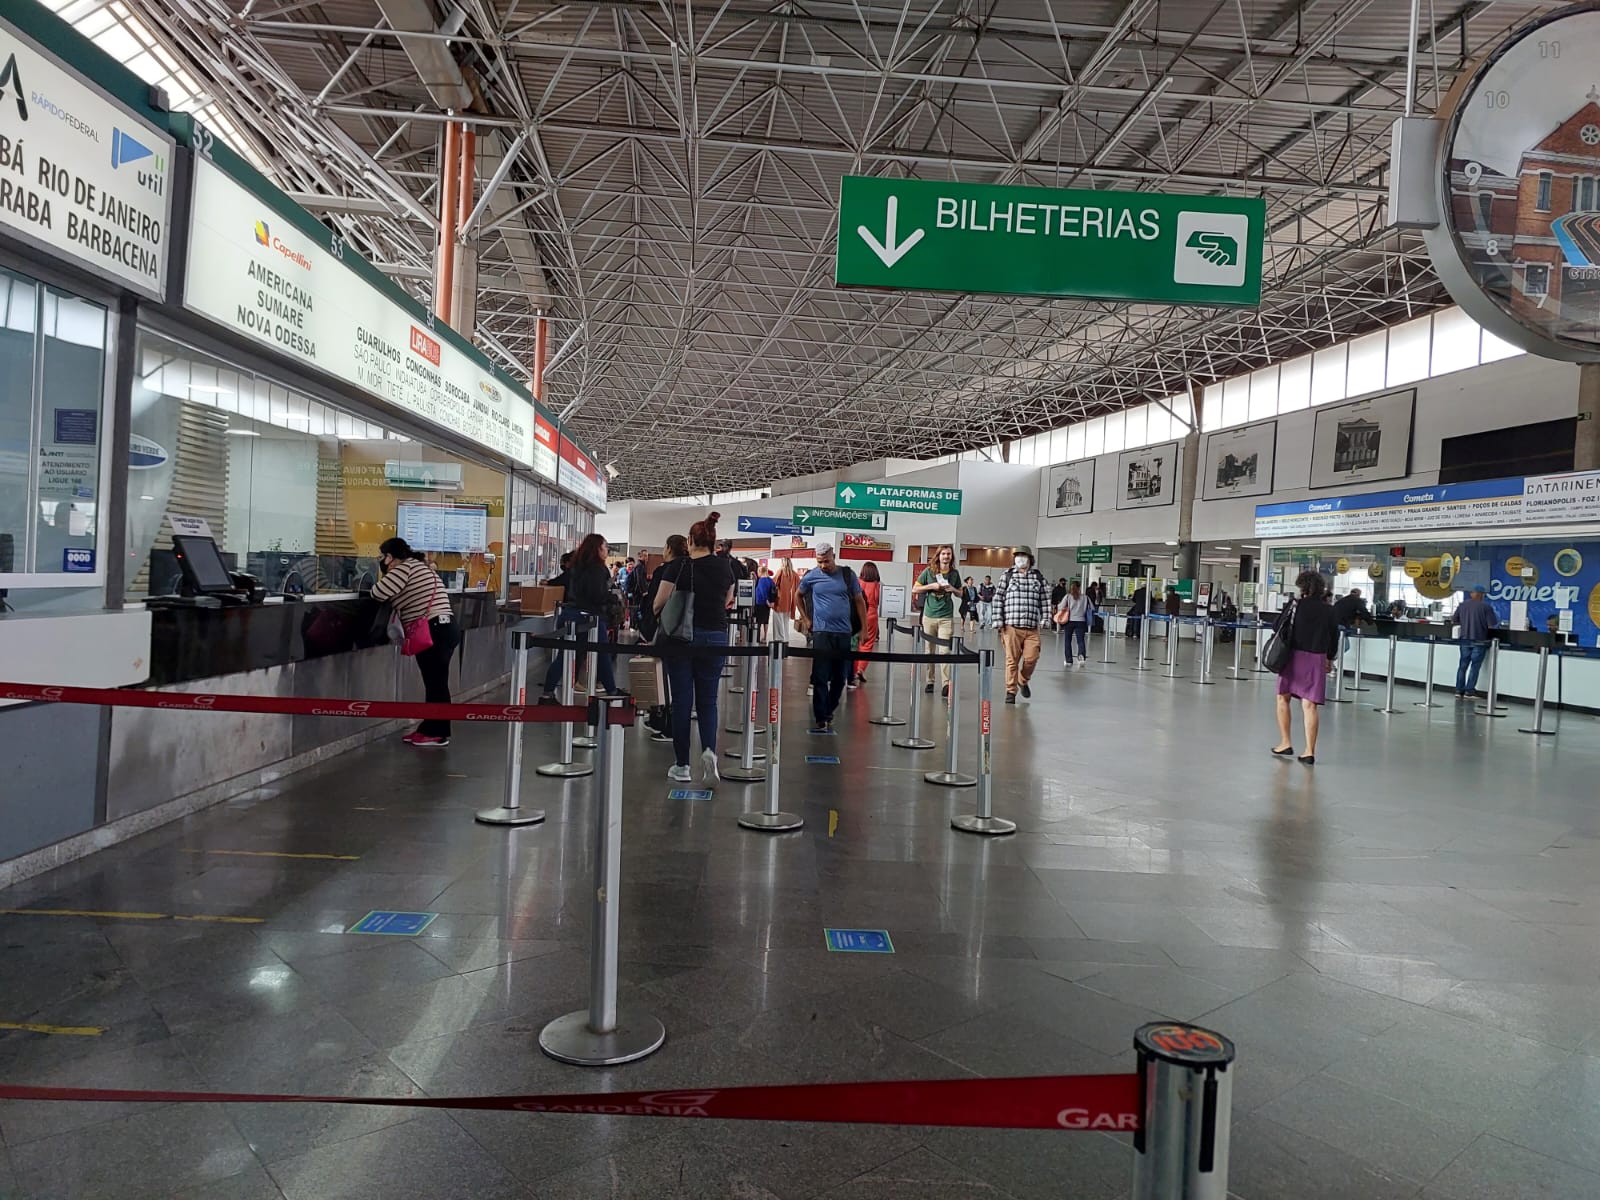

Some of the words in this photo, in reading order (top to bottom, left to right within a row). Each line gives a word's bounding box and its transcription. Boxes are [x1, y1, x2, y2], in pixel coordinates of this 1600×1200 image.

[1538, 41, 1560, 58] 11
[1484, 91, 1510, 108] 10
[192, 120, 214, 159] 52
[138, 169, 163, 196] util
[1464, 162, 1482, 186] 9
[38, 156, 70, 197] RIO
[74, 176, 96, 212] DE
[99, 191, 160, 245] JANEIRO
[0, 177, 52, 230] RABA
[66, 211, 158, 279] BARBACENA
[935, 196, 1160, 240] BILHETERIAS
[272, 236, 312, 272] Capellini
[330, 234, 344, 260] 53
[1486, 240, 1499, 256] 8
[248, 259, 313, 313] AMERICANA
[256, 289, 304, 330] SUMARÉ
[236, 304, 272, 337] NOVA
[275, 324, 316, 360] ODESSA
[354, 344, 368, 364] SÃO
[356, 326, 400, 364] GUARULHOS
[406, 356, 442, 388] CONGONHAS
[866, 486, 942, 500] PLATAFORMAS
[1403, 493, 1434, 503] Cometa
[812, 510, 868, 520] INFORMAÇÕES
[880, 499, 938, 510] EMBARQUE
[311, 708, 368, 716] GARDENIA
[466, 712, 522, 721] GARDENIA
[513, 1102, 709, 1116] GARDENIA
[1056, 1108, 1141, 1129] GAR
